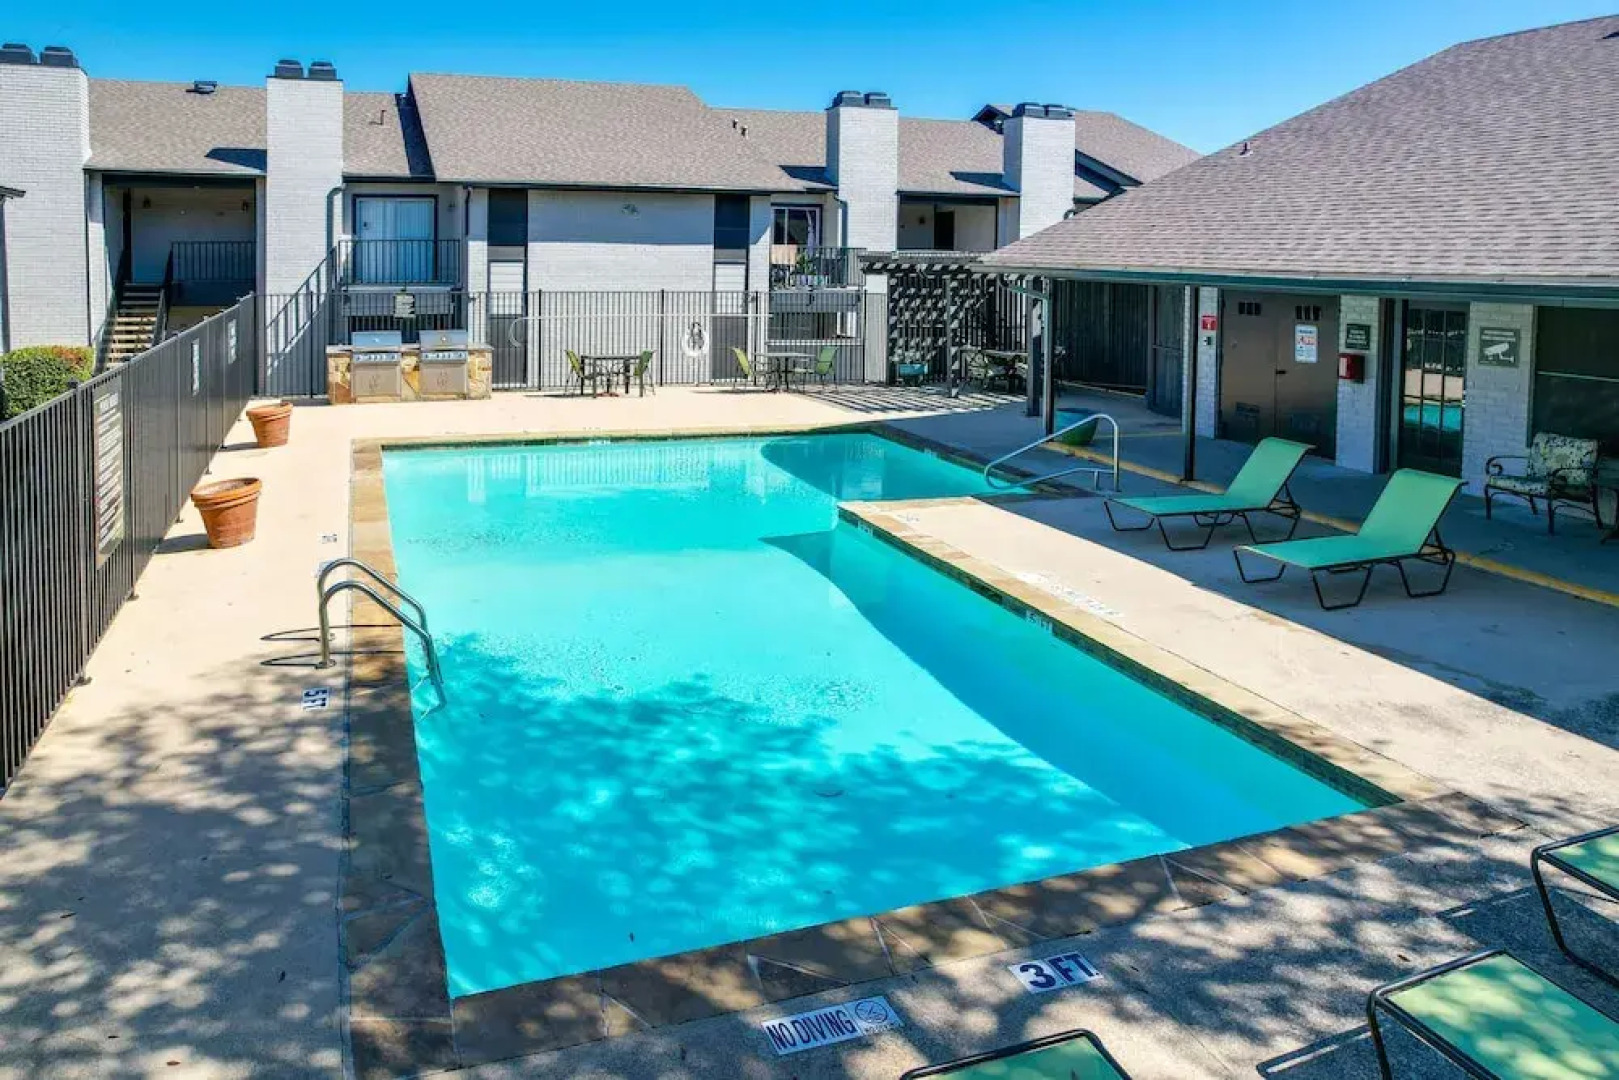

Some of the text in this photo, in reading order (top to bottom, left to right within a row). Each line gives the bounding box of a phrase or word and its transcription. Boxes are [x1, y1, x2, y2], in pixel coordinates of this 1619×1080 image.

[1020, 964, 1056, 988] 3
[766, 1022, 797, 1050] NO
[790, 1010, 858, 1044] DIVING
